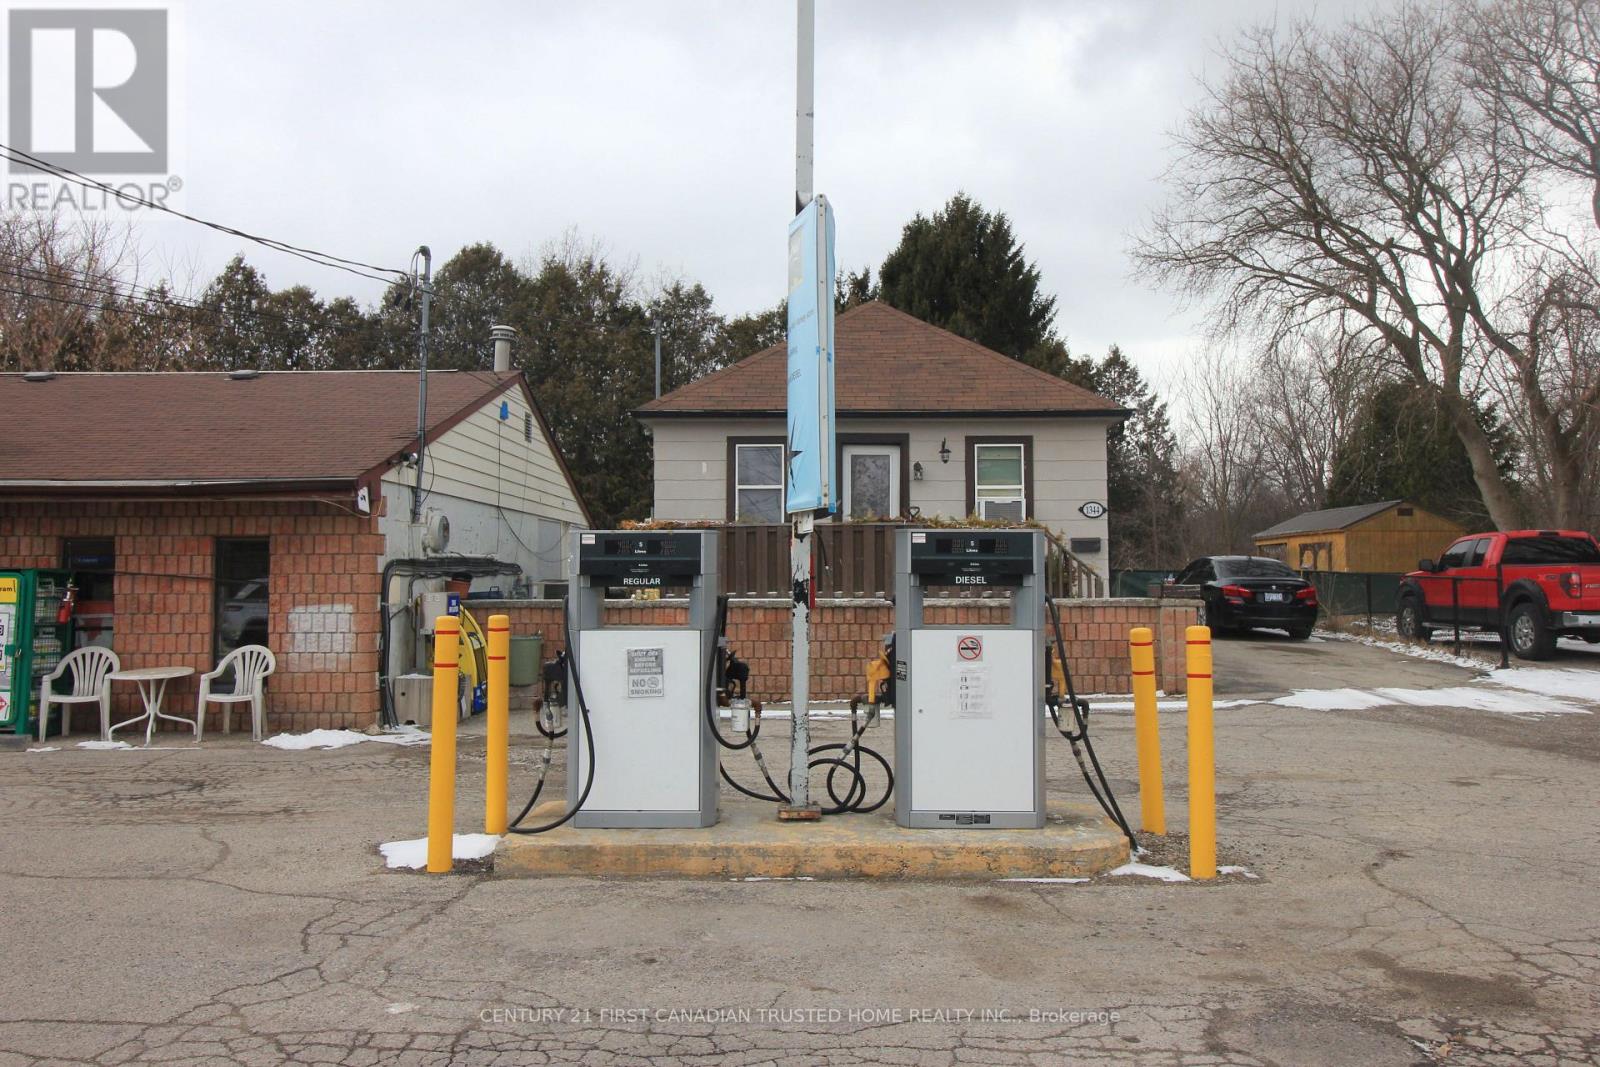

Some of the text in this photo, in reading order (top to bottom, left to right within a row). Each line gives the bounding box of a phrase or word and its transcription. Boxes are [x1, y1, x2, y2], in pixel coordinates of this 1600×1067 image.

[1086, 505, 1100, 515] 1344
[623, 577, 661, 585] REGULAR
[955, 576, 987, 584] DIESEL
[632, 678, 646, 687] NO
